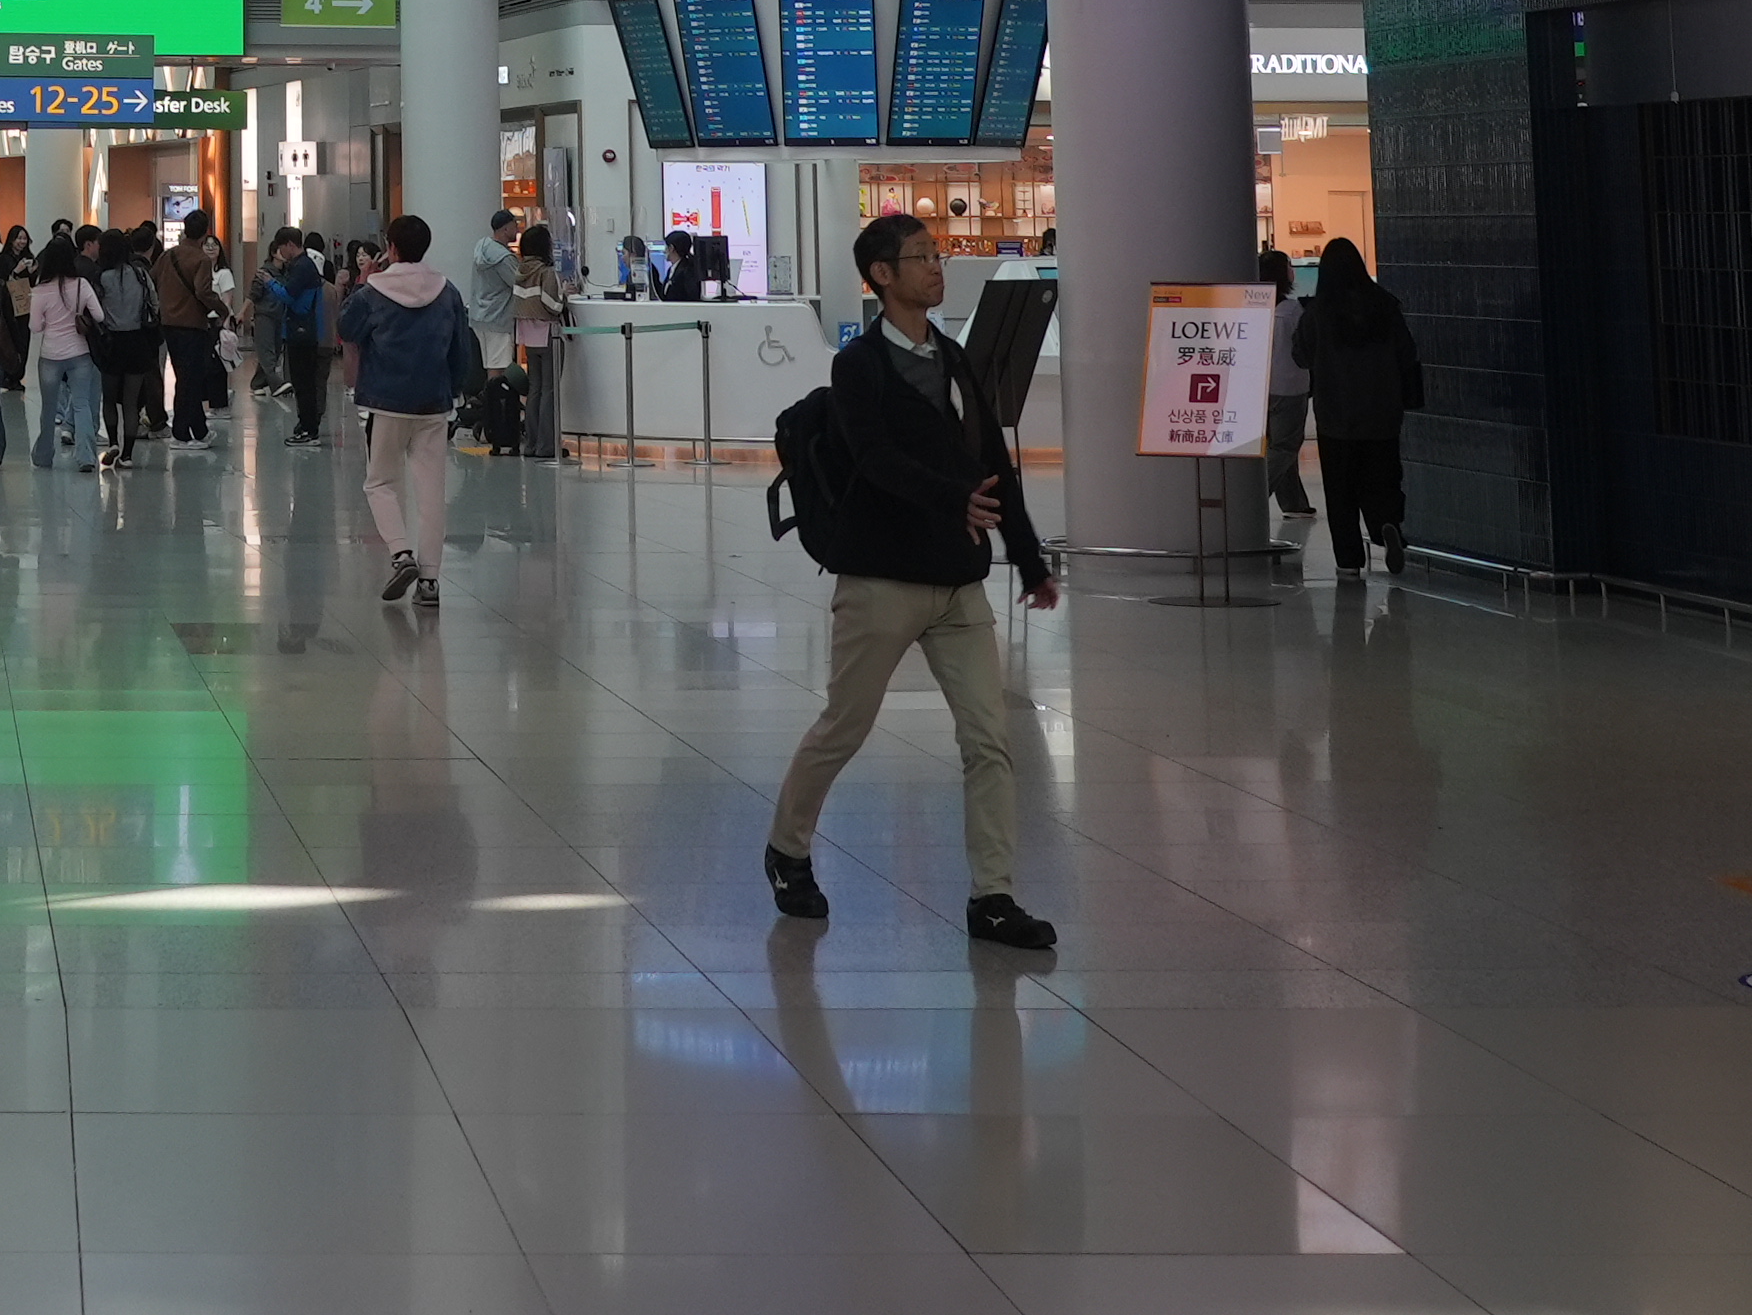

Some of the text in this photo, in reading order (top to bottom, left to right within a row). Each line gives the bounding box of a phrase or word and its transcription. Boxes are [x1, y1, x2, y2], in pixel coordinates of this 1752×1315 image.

[8, 45, 57, 65] 탑승구
[64, 40, 136, 55] 登机口 ゲート
[62, 56, 104, 72] Gates
[1250, 54, 1369, 74] RADITIONA
[30, 85, 120, 116] 12-25
[191, 96, 231, 114] Desk
[1244, 289, 1271, 300] New
[1171, 321, 1249, 340] LOEWE
[1177, 346, 1236, 367] 罗意威
[1168, 409, 1238, 424] 신상품 입고
